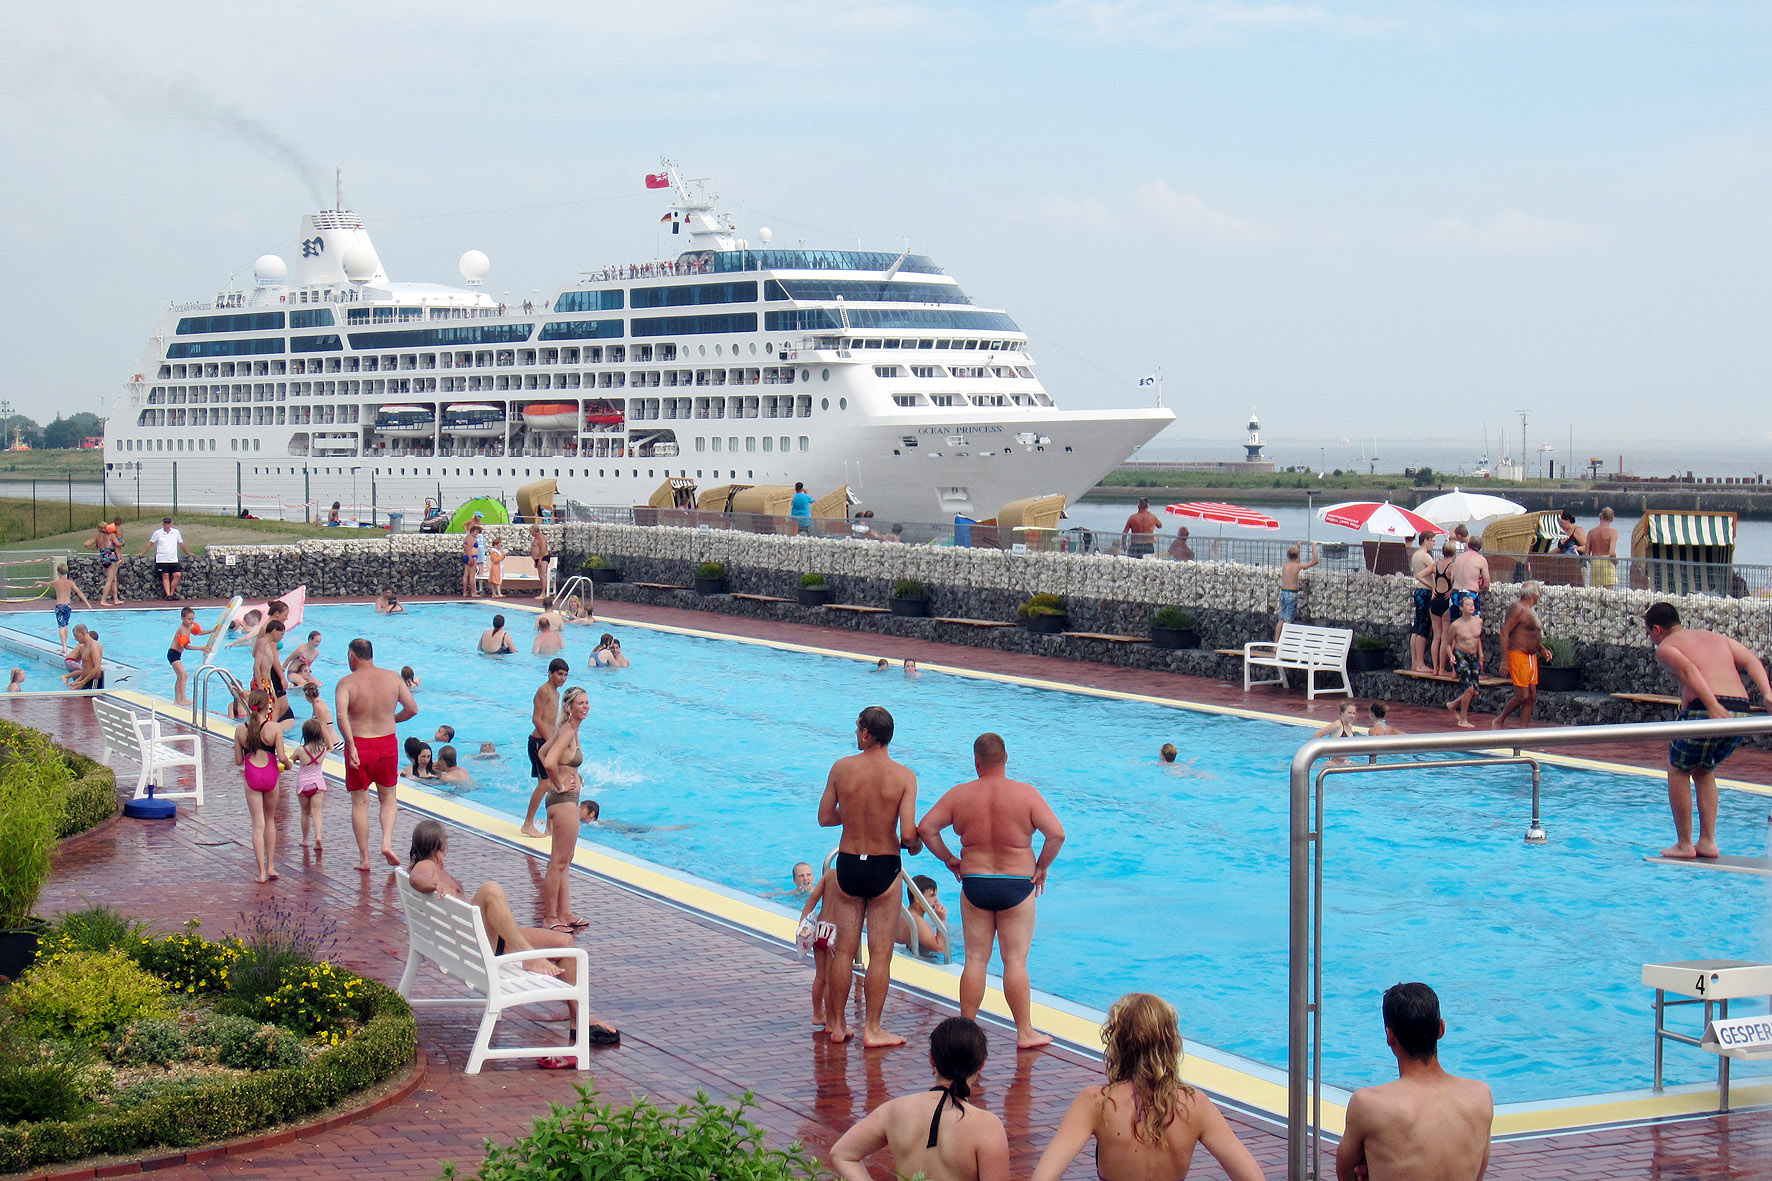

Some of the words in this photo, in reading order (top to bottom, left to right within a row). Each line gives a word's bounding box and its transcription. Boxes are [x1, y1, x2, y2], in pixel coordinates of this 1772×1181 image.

[175, 304, 189, 312] OCEAN
[918, 427, 950, 435] OCEAN
[956, 426, 1003, 434] PRINCESS
[1696, 974, 1705, 995] 4
[1720, 1022, 1772, 1045] GESPER
